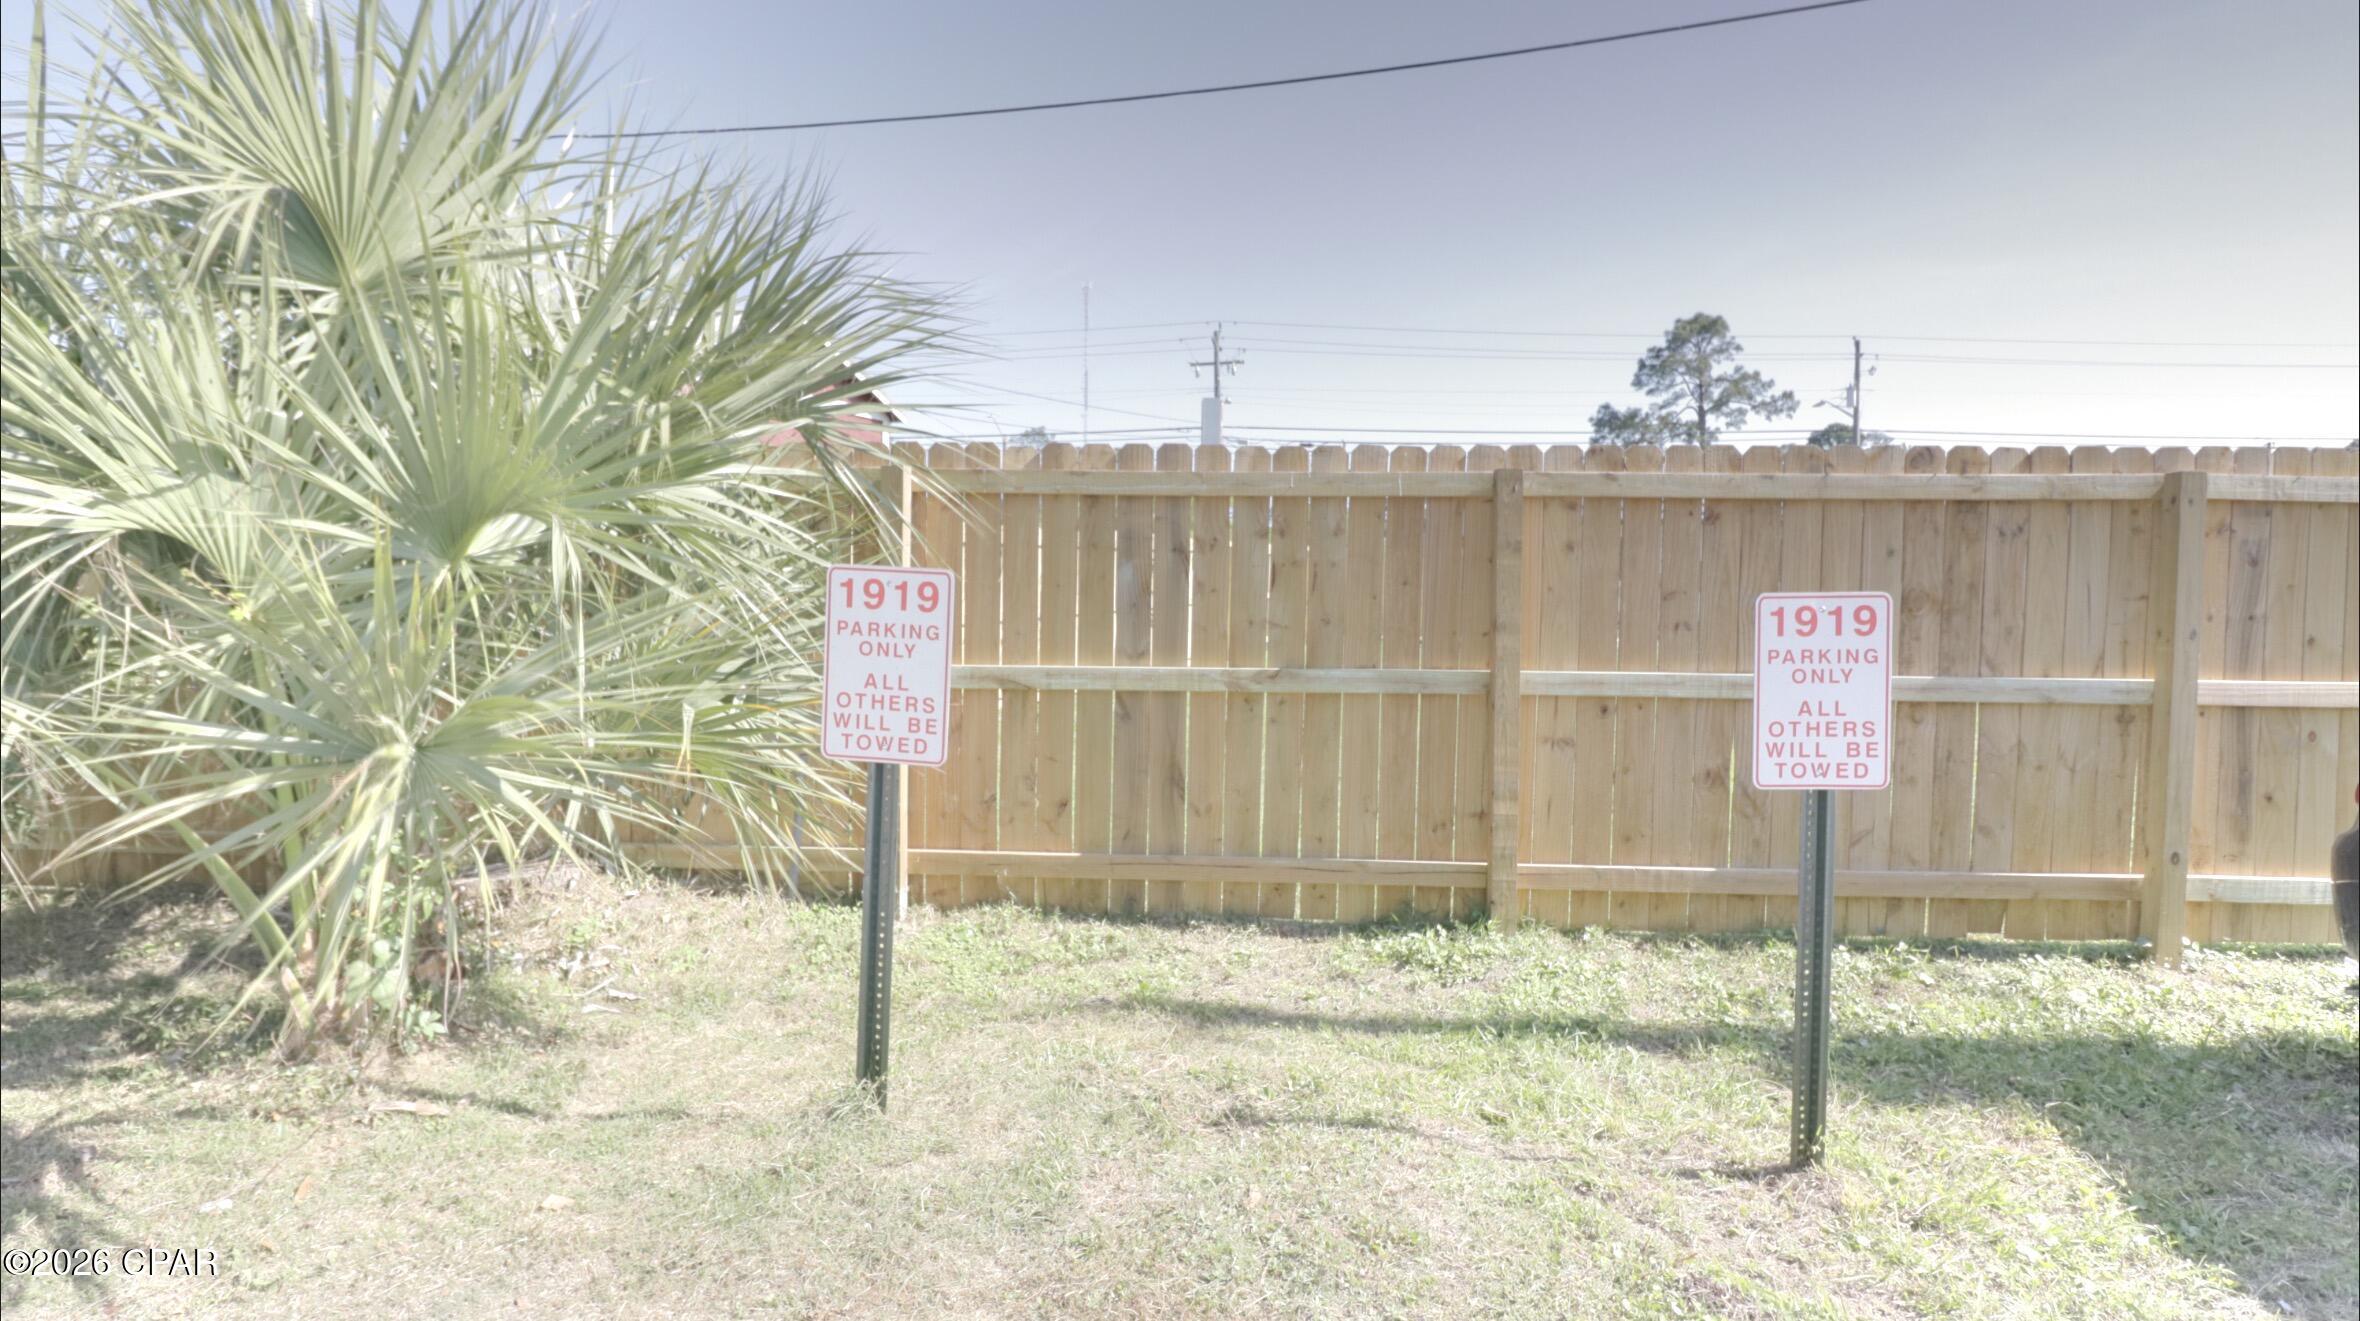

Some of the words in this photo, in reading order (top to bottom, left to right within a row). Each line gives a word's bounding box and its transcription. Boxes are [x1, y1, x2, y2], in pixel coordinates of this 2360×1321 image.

[840, 578, 940, 613] 1919
[1770, 604, 1878, 637] 1919
[837, 620, 940, 641] PARKING
[859, 641, 916, 659] ONLY
[1767, 648, 1879, 665] PARKING
[864, 673, 909, 691] ALL
[1791, 668, 1853, 684] ONLY
[836, 691, 935, 714] OTHERS
[1797, 700, 1847, 717] ALL
[833, 712, 891, 731] WILL
[908, 717, 937, 735] BE
[1768, 721, 1876, 738] OTHERS
[841, 733, 928, 755] TOWED
[1765, 742, 1827, 758] WILL
[1846, 742, 1879, 758] BE
[1774, 762, 1869, 779] TOWED
